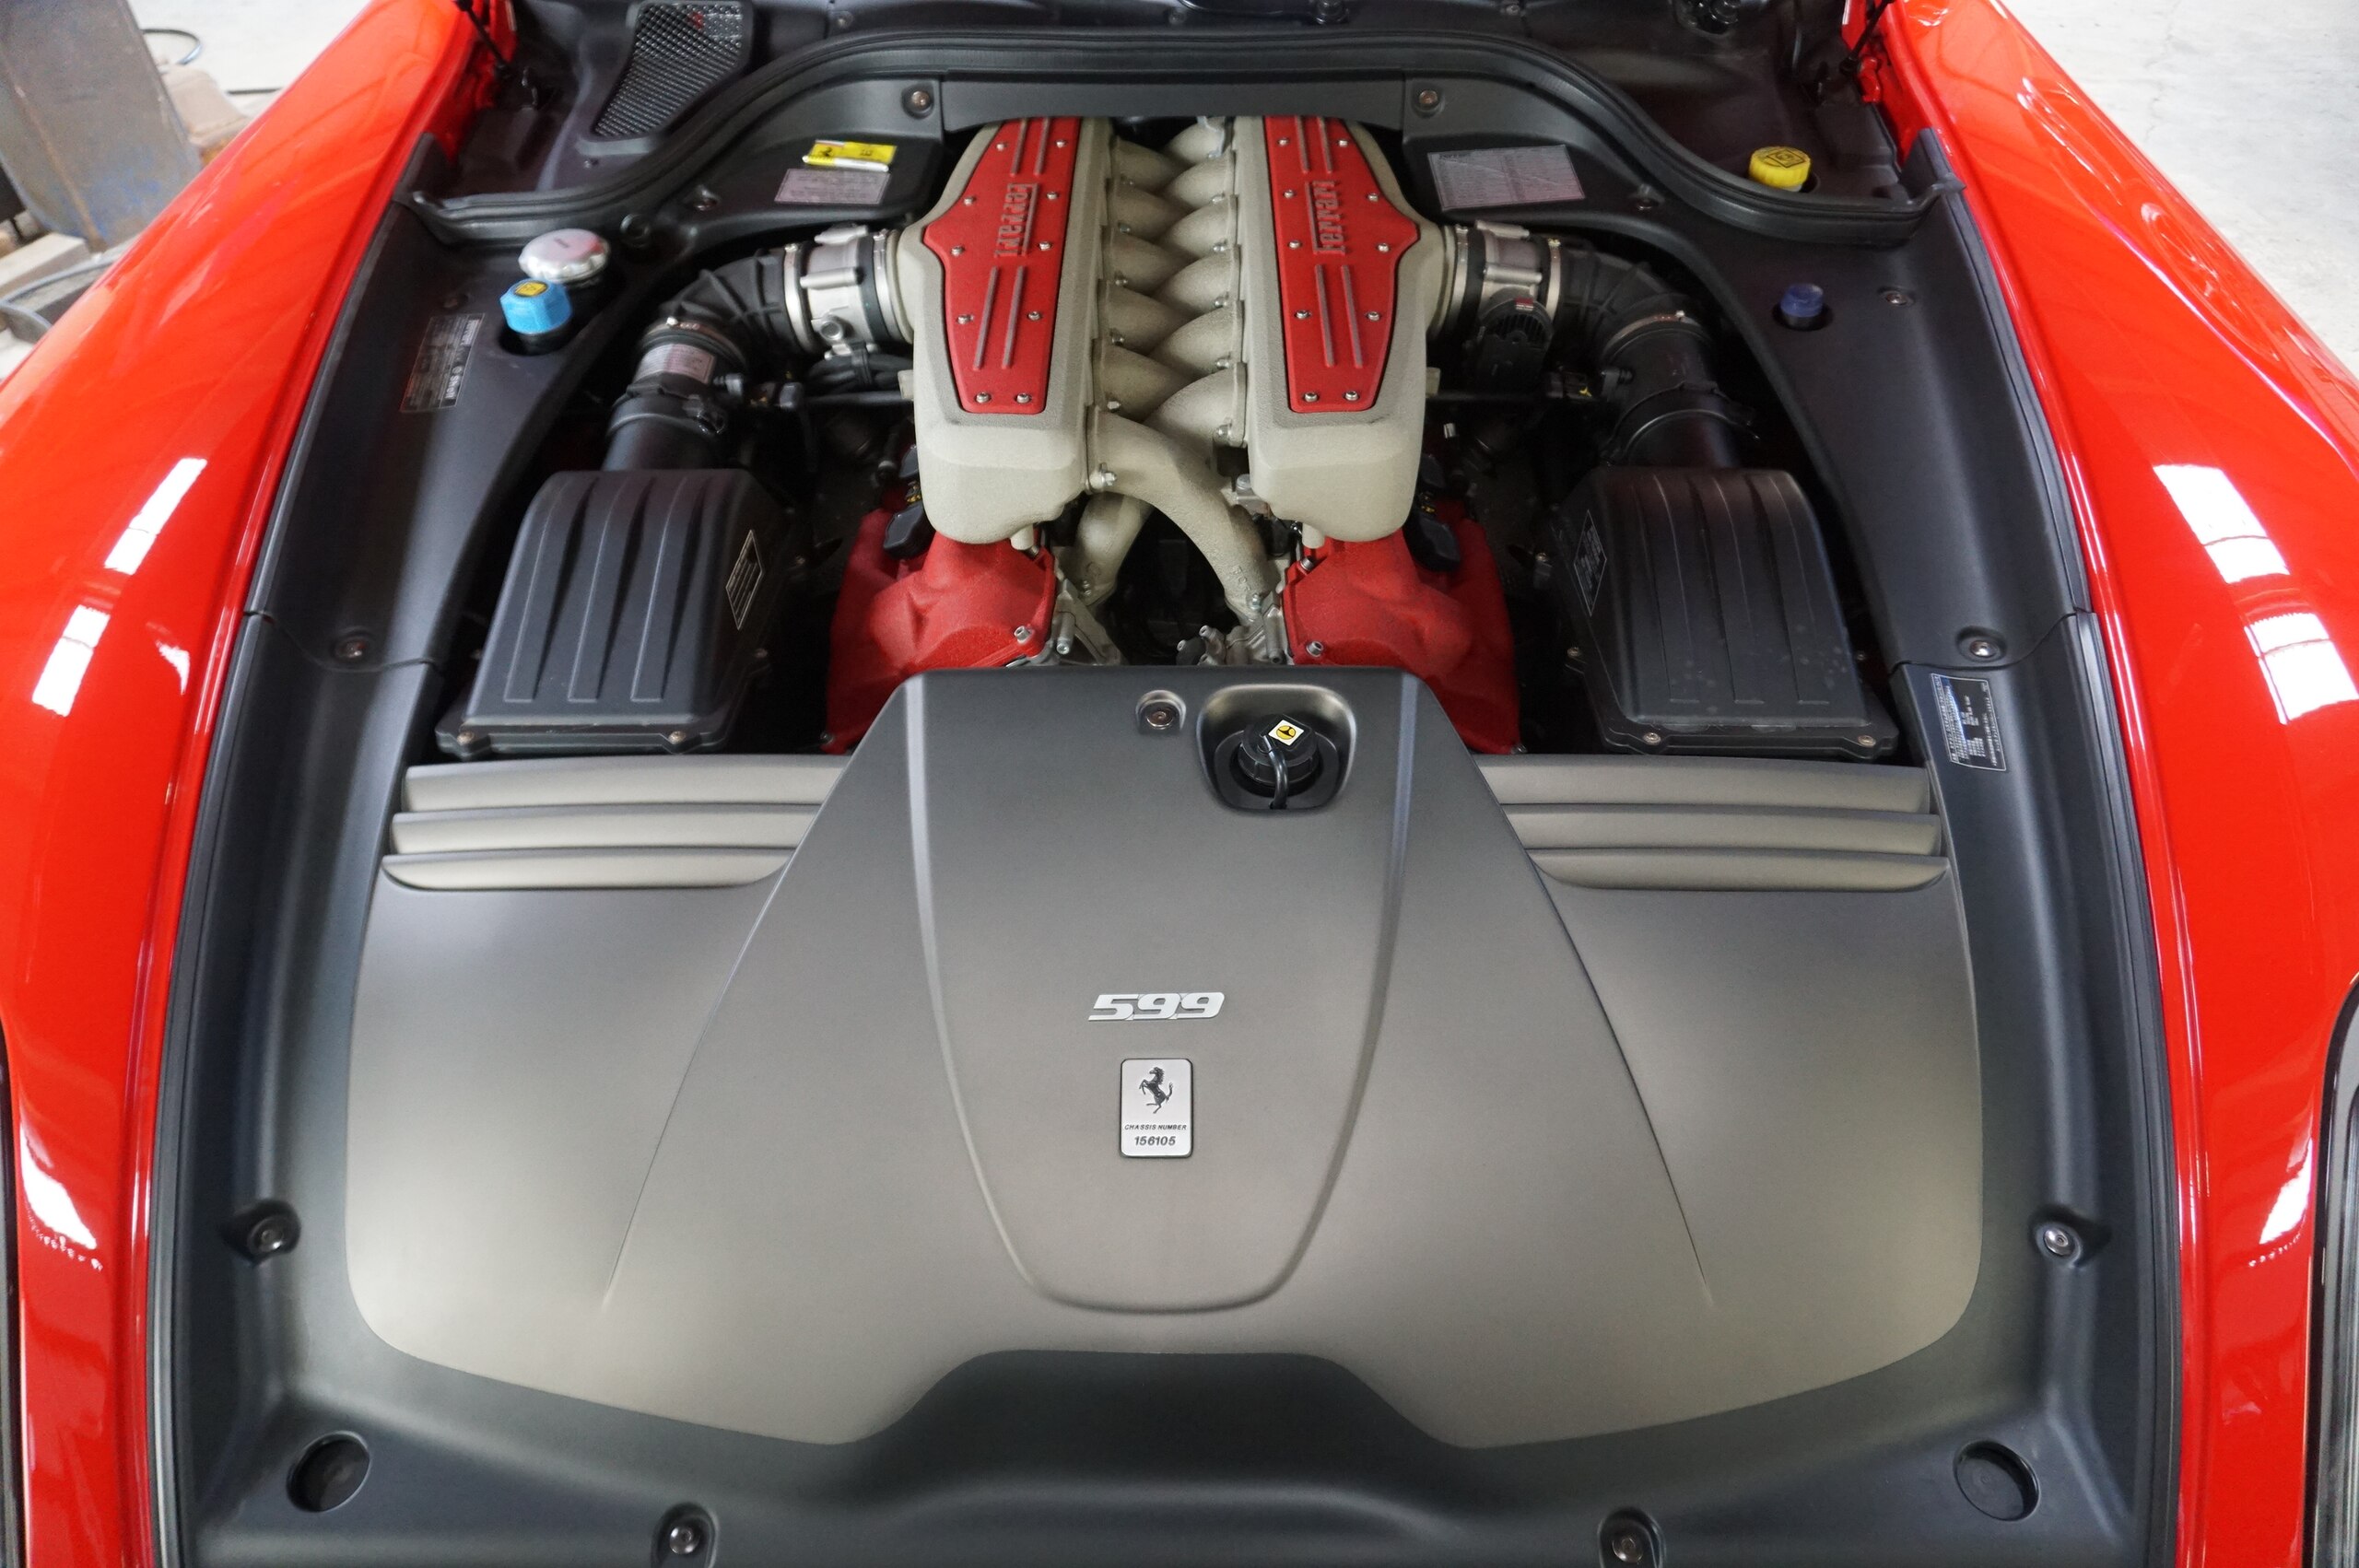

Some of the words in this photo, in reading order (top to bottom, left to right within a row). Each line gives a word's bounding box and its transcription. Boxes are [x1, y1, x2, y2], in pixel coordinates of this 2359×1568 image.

[994, 183, 1039, 258] Ferrari
[1305, 181, 1345, 255] Ferrari
[444, 374, 461, 399] Shell
[1088, 992, 1226, 1021] 599
[1134, 1136, 1177, 1146] 156105
